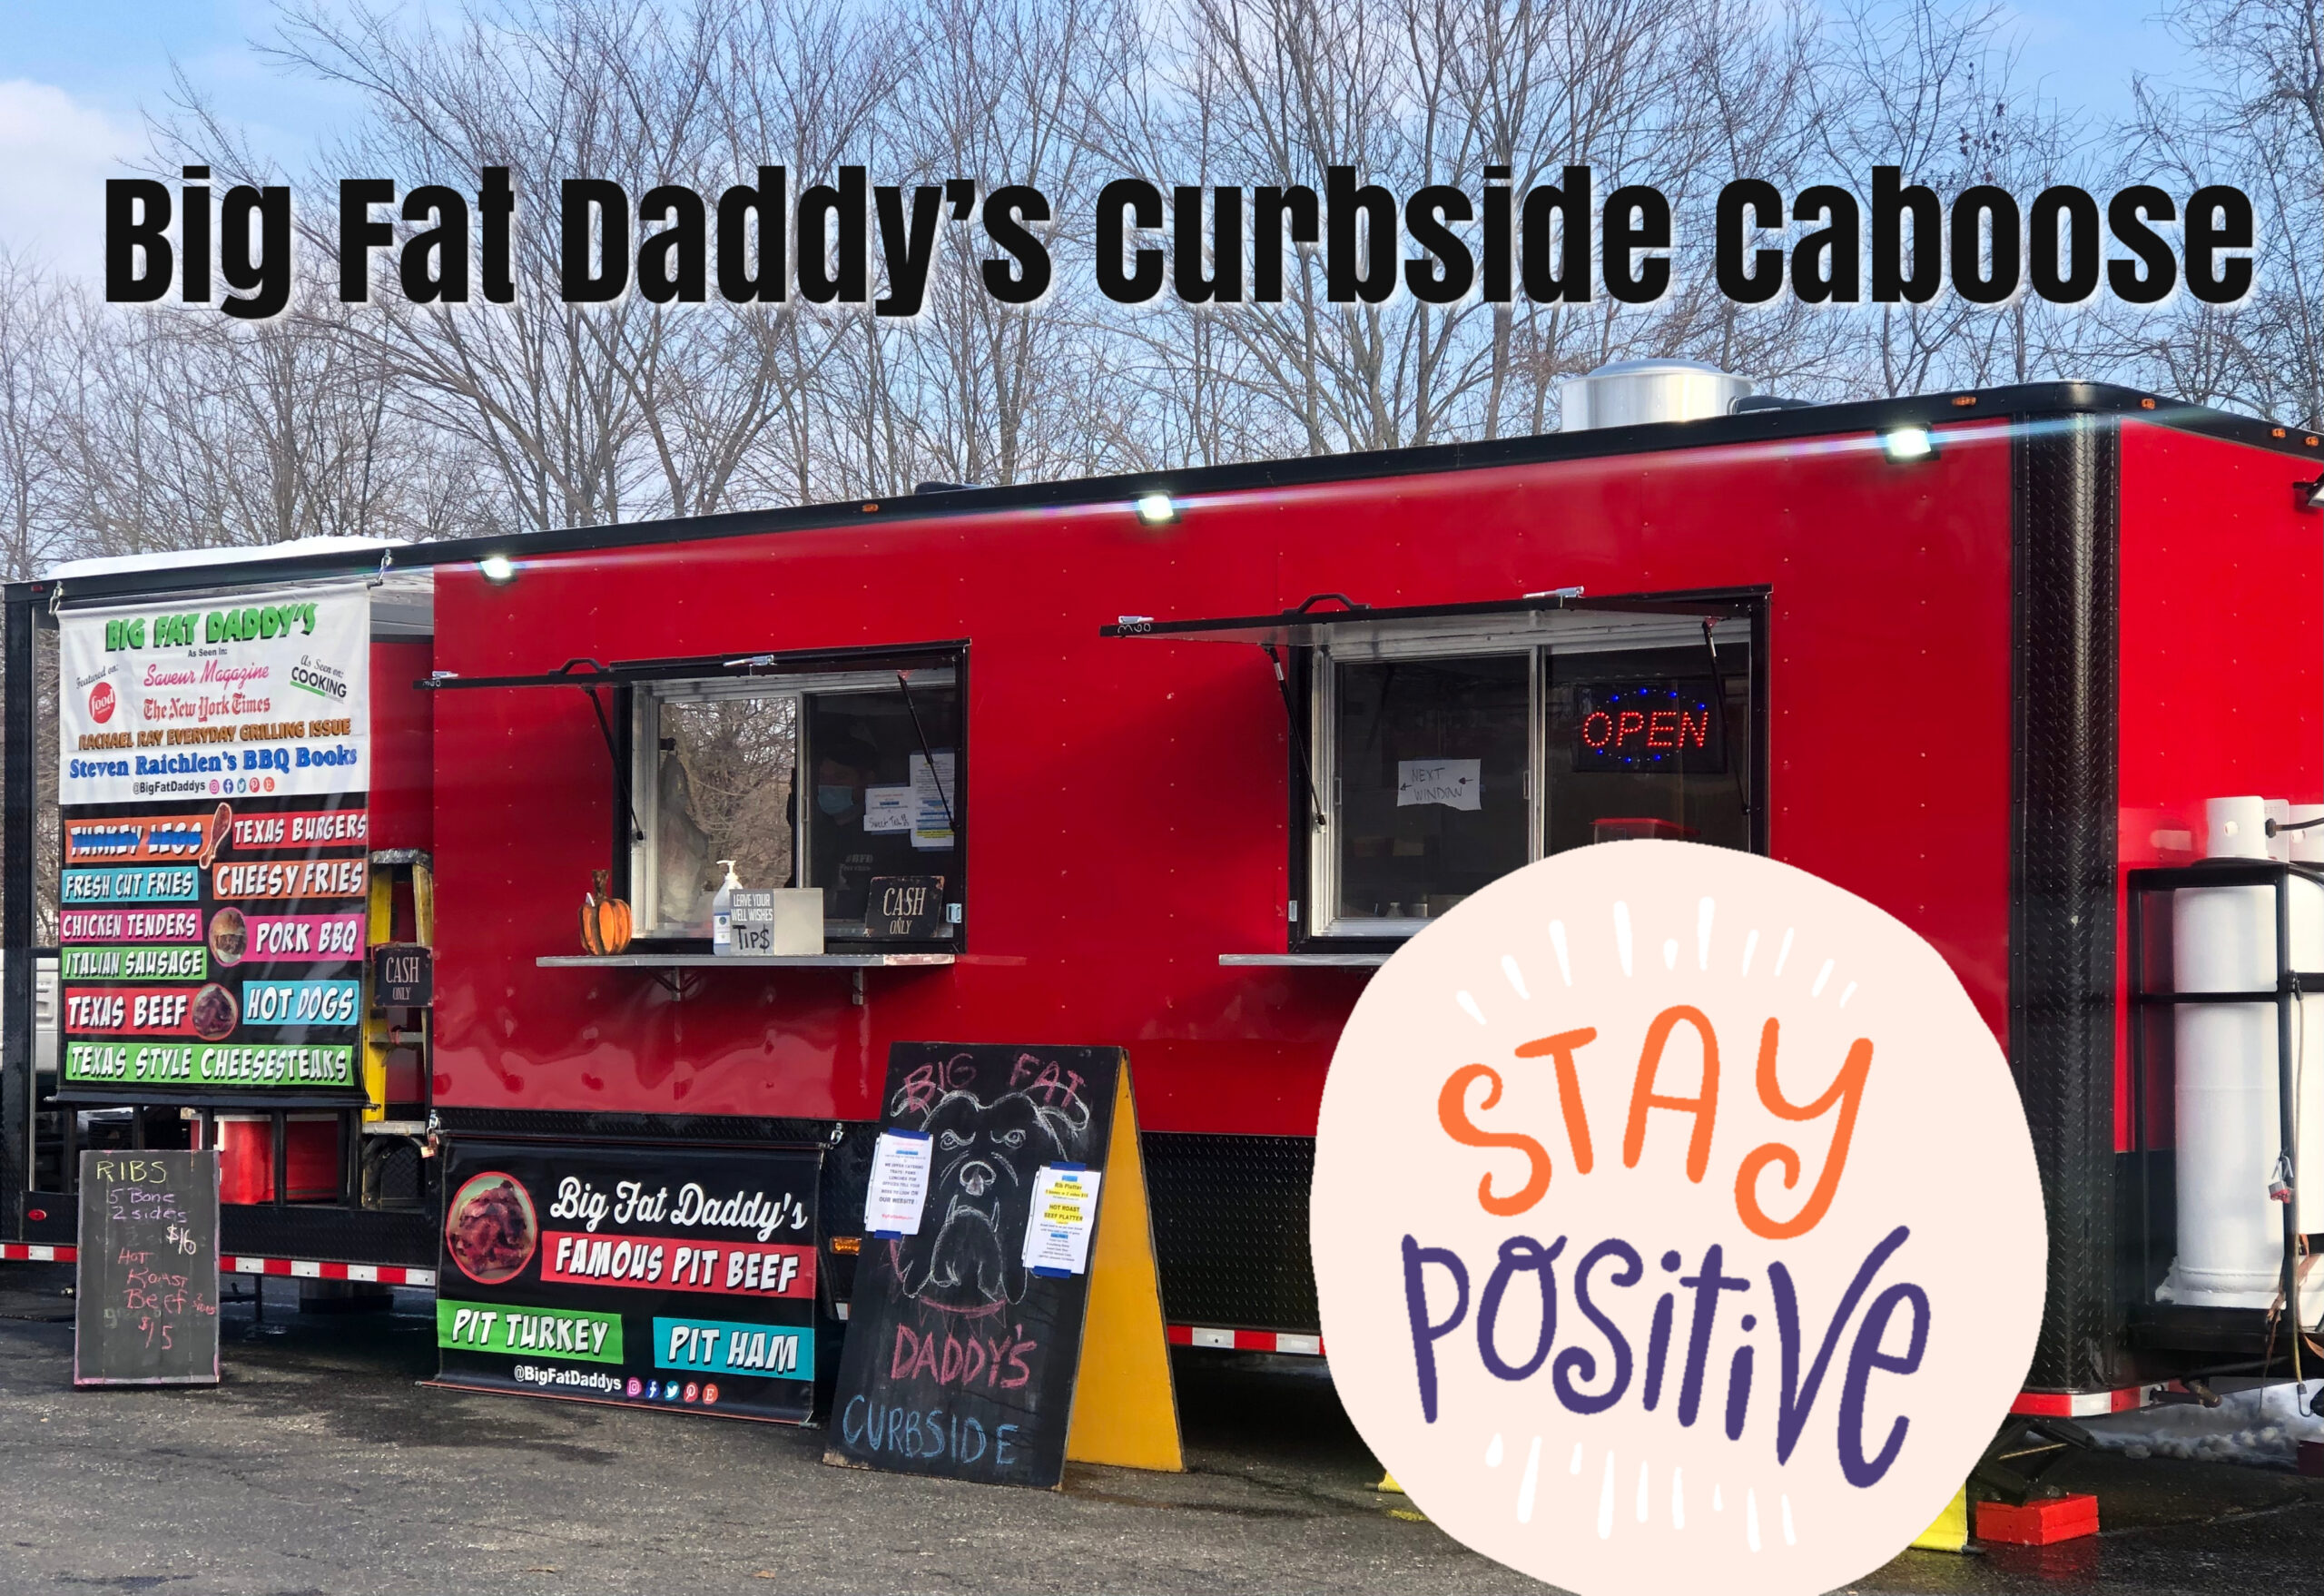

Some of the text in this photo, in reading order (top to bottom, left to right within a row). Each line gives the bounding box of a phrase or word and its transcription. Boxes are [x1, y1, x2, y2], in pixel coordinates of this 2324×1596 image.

[105, 603, 318, 652] BIG FAT DADDY'S
[188, 647, 228, 657] As Seen In:
[300, 655, 311, 667] As
[314, 659, 331, 674] Seen
[76, 665, 106, 689] Featured
[143, 659, 270, 689] Saveur Magazine
[291, 666, 347, 698] COOKING
[92, 688, 114, 718] food
[143, 693, 271, 723] The New York Times
[79, 718, 350, 750] RACHAEL RAY EVERYDAY GRILLING ISSUE
[1583, 711, 1709, 748] OPEN
[69, 744, 358, 779] Steven Raichlen's BBQ Books
[1412, 768, 1445, 783] NEXT
[133, 781, 206, 794] @BigFatDaddys
[1414, 786, 1462, 801] WINDOW
[234, 813, 366, 843] TEXAS BURGERS
[65, 871, 194, 899] FRESH CUT FRIES
[216, 862, 362, 896] CHEESY FRIES
[731, 909, 773, 921] WELL WISHES
[734, 893, 770, 907] LEAVE YOUR
[883, 887, 926, 916] CASH
[63, 913, 196, 937] CHICKEN TENDERS
[256, 921, 358, 954] PORK BBQ
[890, 918, 912, 934] ONLY
[65, 950, 202, 975] ITALIAN SAUSAGE
[386, 957, 419, 983] CASH
[247, 987, 353, 1020] HOT DOGS
[392, 987, 410, 1000] ONLY
[68, 995, 187, 1027] TEXAS BEEF
[72, 1046, 347, 1079] TEXAS STYLE CHEESESTEAKS
[904, 1052, 1085, 1114] BIG FAT
[96, 1160, 166, 1184] RIBS
[110, 1187, 175, 1205] 5 Bone
[550, 1177, 808, 1243] Big Fat Daddy's
[113, 1206, 188, 1223] 2 sides
[166, 1223, 196, 1255] $16
[555, 1236, 799, 1294] FAMOUS PIT BEEF
[123, 1289, 188, 1315] Beef
[139, 1316, 173, 1349] $15
[451, 1308, 609, 1355] PIT TURKEY
[667, 1326, 799, 1373] PIT HAM
[891, 1323, 1038, 1389] DADDY'S
[514, 1365, 622, 1391] @BigFatDaddys
[842, 1394, 1020, 1465] CURBSIDE
